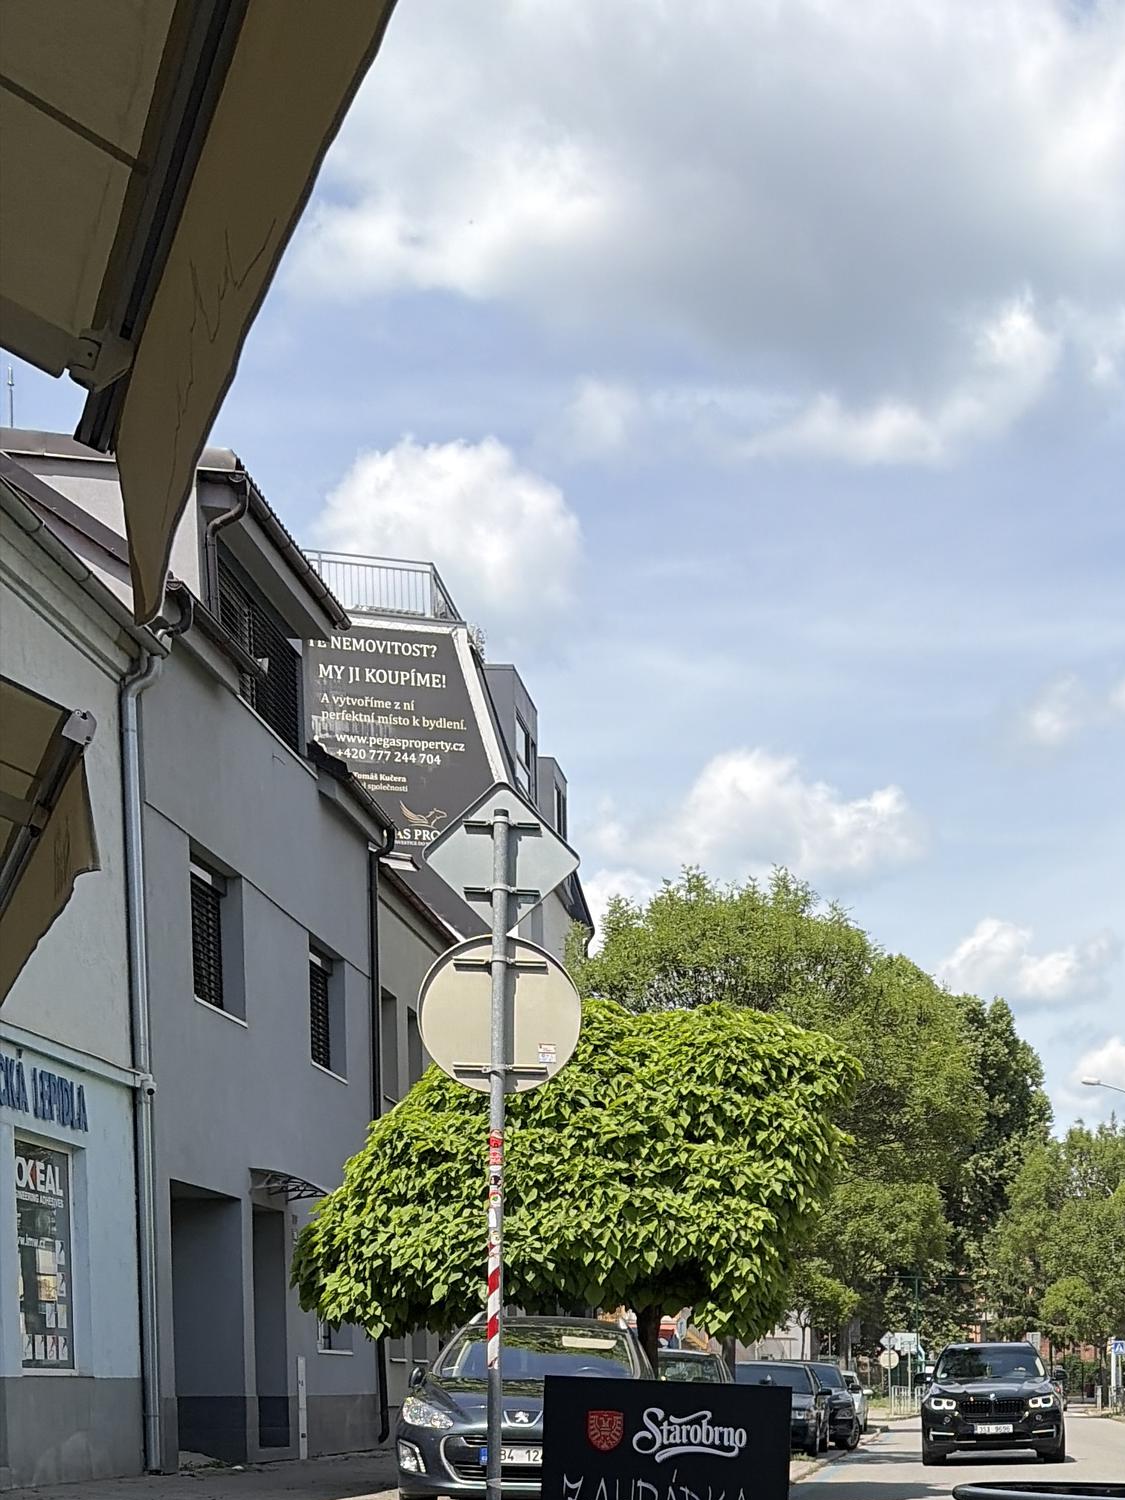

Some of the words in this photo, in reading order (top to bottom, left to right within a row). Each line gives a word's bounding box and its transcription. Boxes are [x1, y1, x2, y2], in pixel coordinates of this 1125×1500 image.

[330, 636, 438, 658] NEMOVITOST?
[318, 663, 345, 680] MY
[348, 667, 361, 684] JI
[365, 668, 447, 689] KOUPÍME!
[320, 693, 330, 704] A
[332, 695, 392, 709] vytvoříme
[394, 702, 401, 710] z
[403, 700, 415, 712] ní
[321, 710, 375, 724] perfektní
[377, 713, 410, 727] místo
[412, 716, 420, 727] k
[422, 717, 467, 731] bydlení.
[335, 733, 466, 753] www.pegasproperty.cz
[336, 749, 367, 760] +420
[369, 750, 391, 762] 777
[394, 752, 417, 764] 244
[419, 754, 442, 766] 704
[379, 773, 407, 783] Kučera
[367, 784, 409, 793] společnosti
[33, 1067, 89, 1132] LEPIDLA
[632, 1407, 747, 1463] Starobrno
